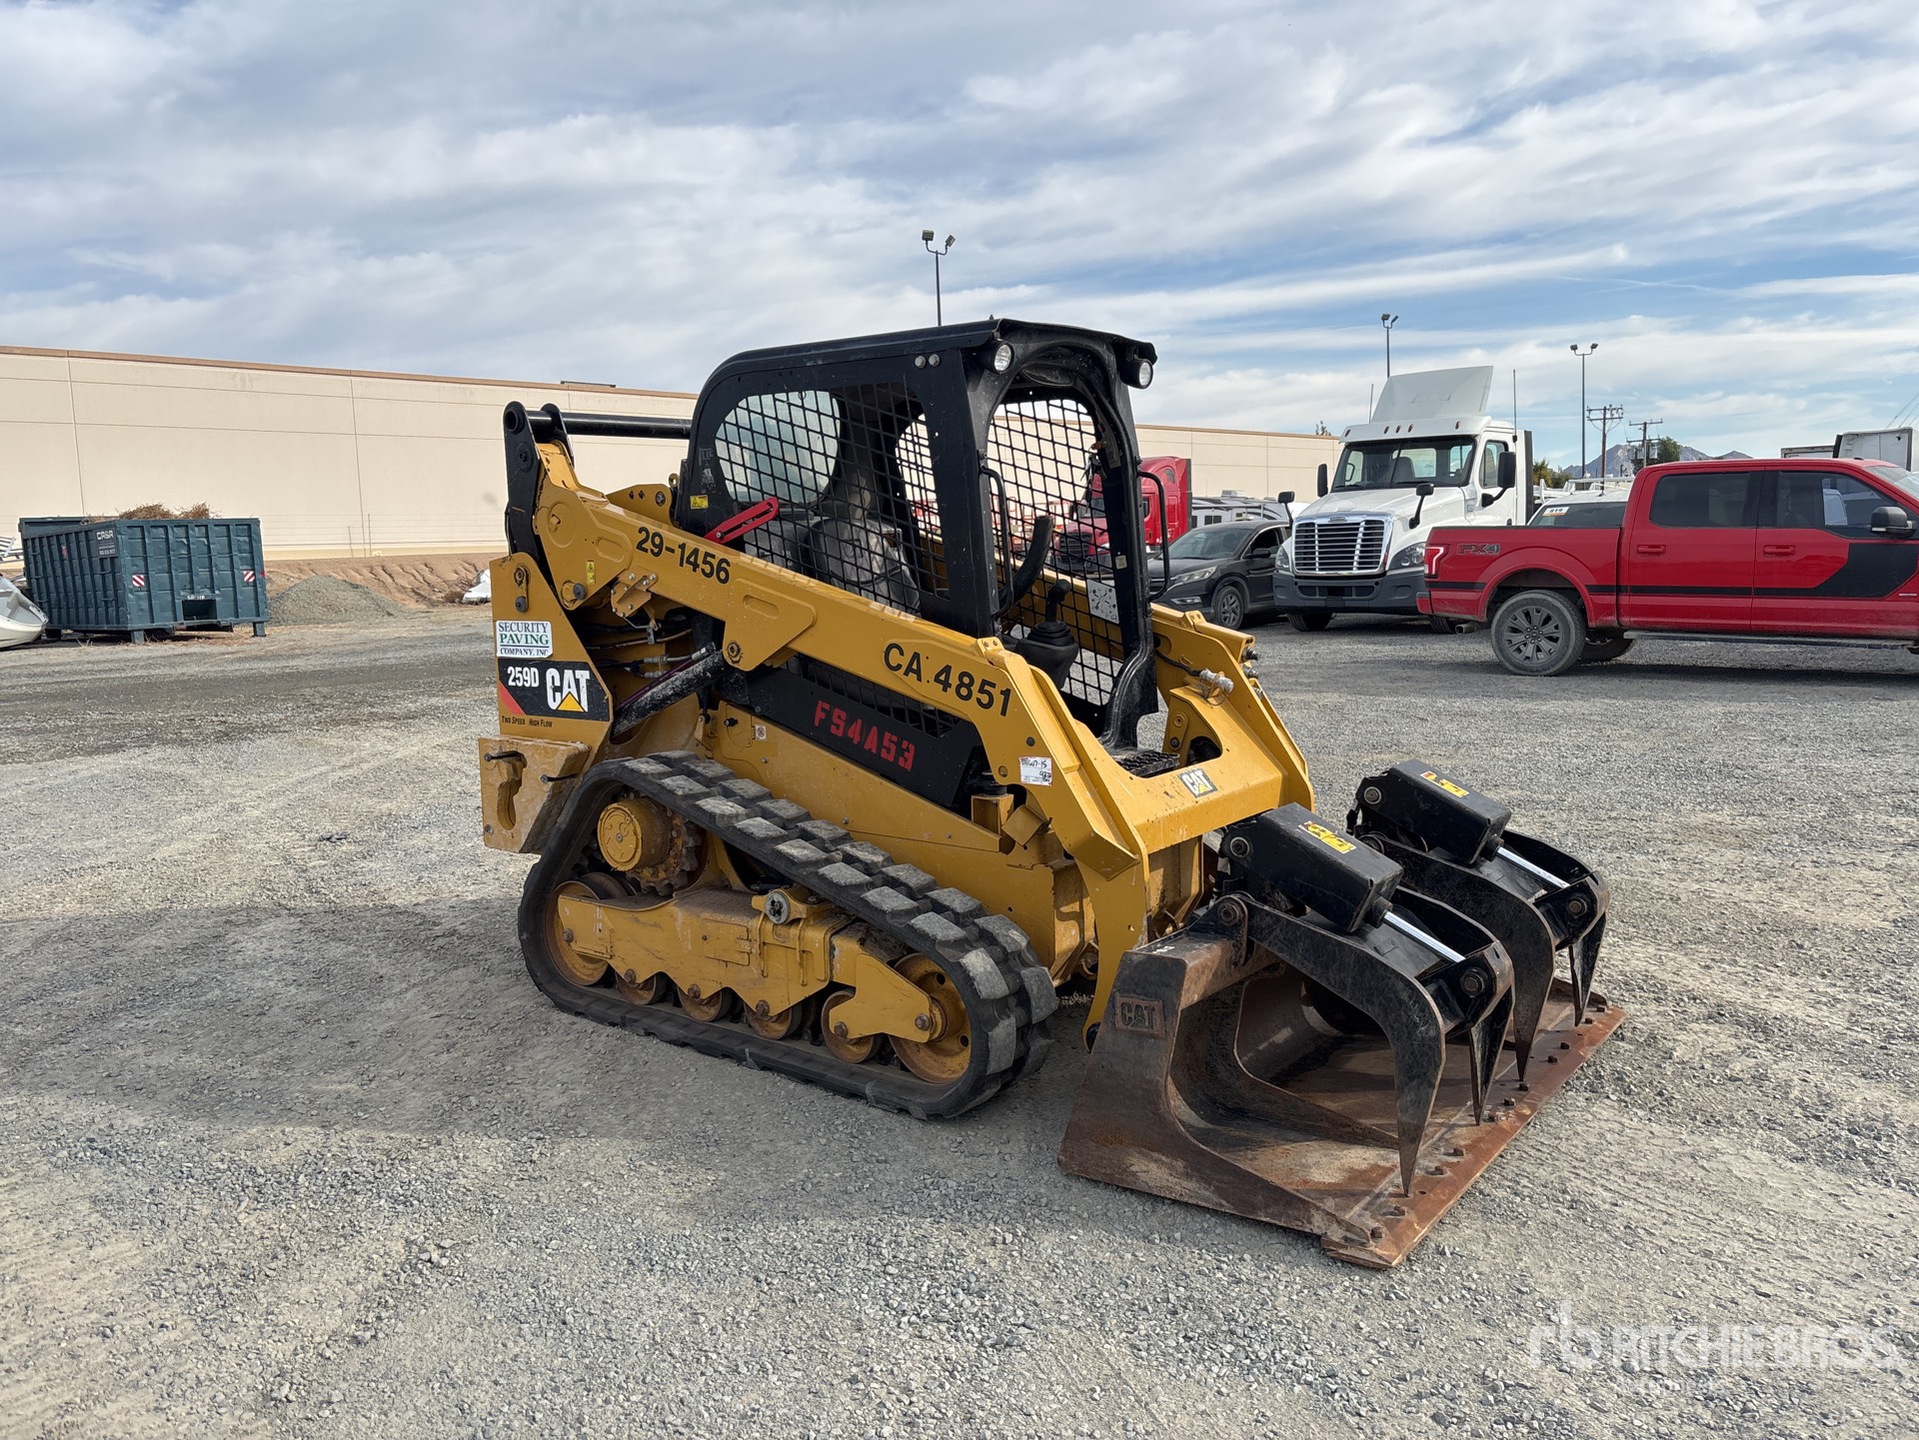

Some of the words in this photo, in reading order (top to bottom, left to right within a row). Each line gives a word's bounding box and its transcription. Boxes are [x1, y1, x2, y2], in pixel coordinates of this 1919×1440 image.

[636, 527, 731, 585] 29-1456
[1457, 543, 1500, 555] FX4
[498, 621, 548, 633] SECURITY
[500, 633, 549, 645] PAVING
[507, 666, 539, 687] 259D
[545, 668, 590, 713] CAT
[933, 664, 1011, 717] 4851
[814, 700, 916, 771] FS4A53
[1181, 770, 1213, 796] CAT
[1121, 1002, 1155, 1030] CAT
